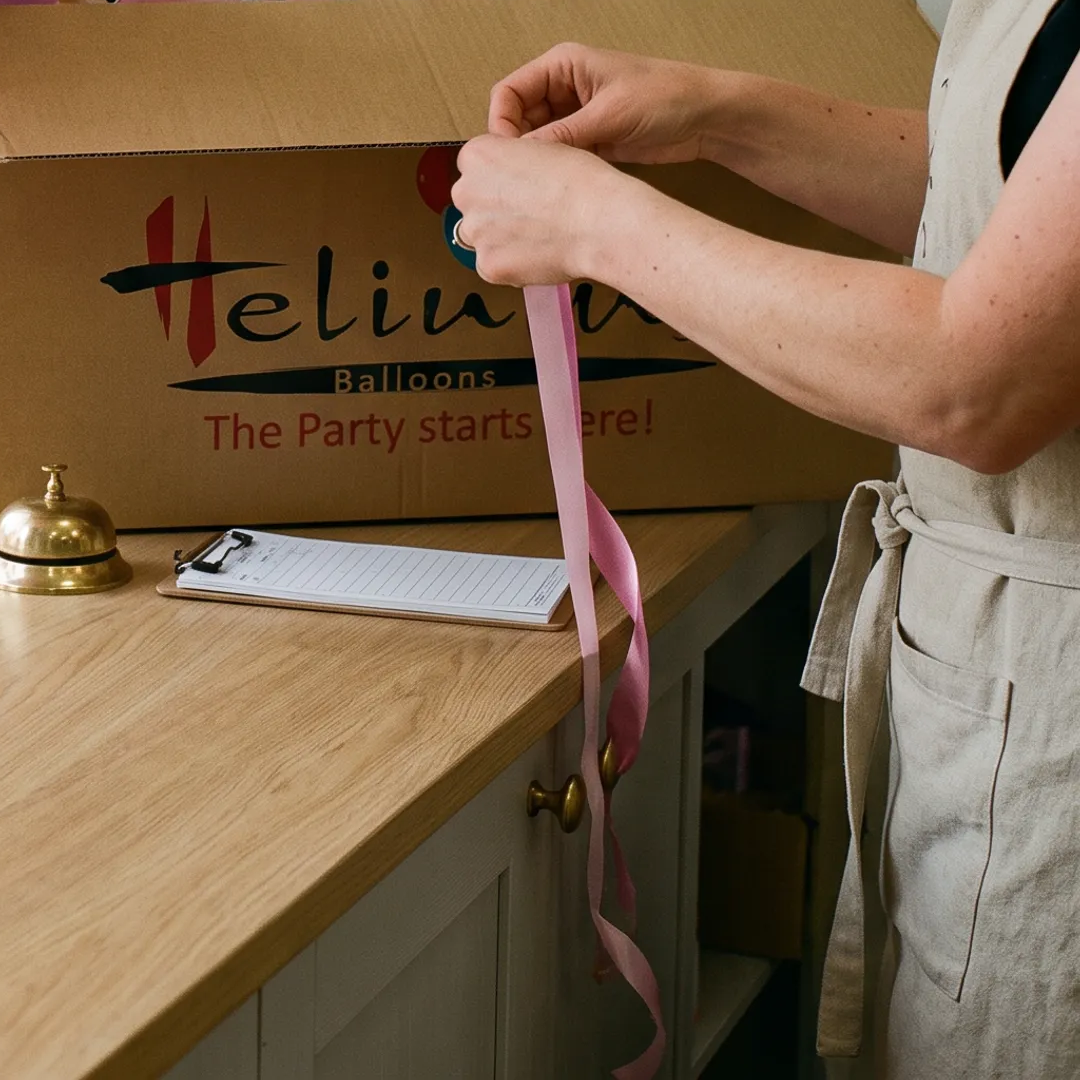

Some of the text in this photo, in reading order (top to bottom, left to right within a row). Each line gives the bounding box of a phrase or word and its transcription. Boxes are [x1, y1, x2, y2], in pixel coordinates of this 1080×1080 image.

[334, 364, 497, 394] Balloons
[203, 398, 654, 454] The Party starts ere!
